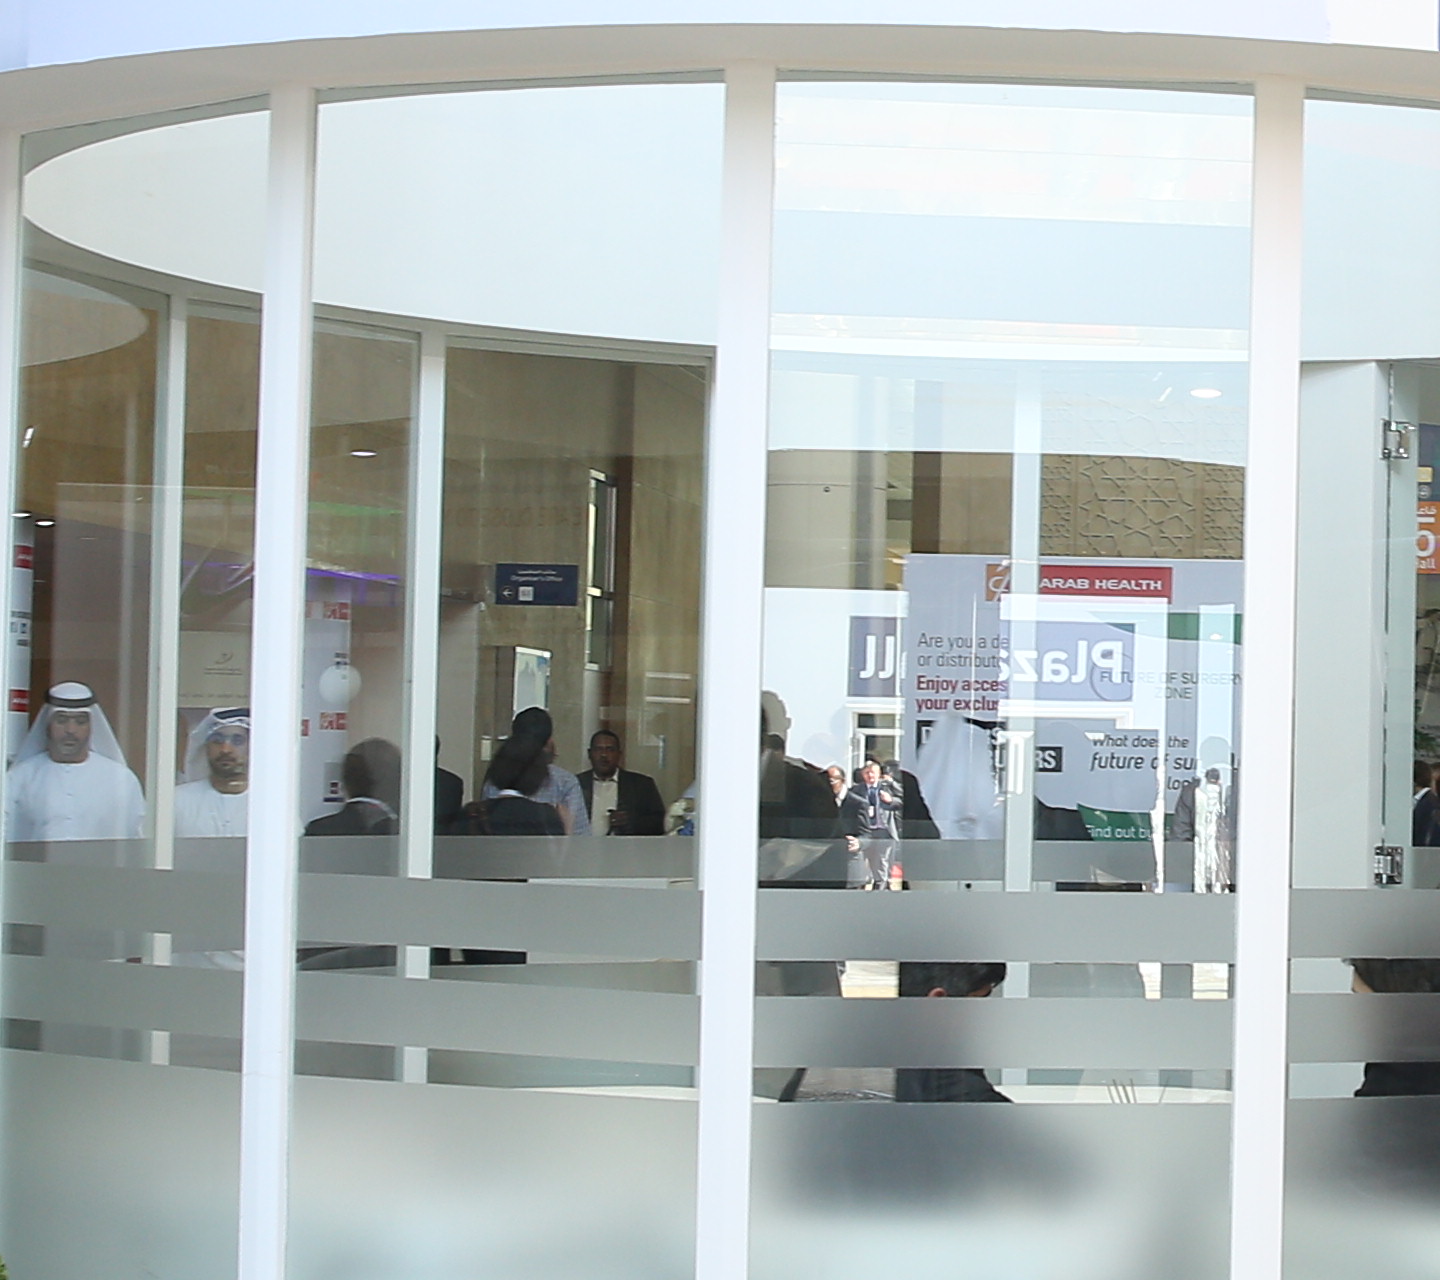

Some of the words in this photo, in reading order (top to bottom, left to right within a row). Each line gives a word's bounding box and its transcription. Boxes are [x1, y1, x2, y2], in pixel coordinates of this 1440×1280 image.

[1039, 578, 1088, 590] ARAB
[1094, 578, 1162, 591] HEALTH
[918, 633, 945, 648] Are
[947, 636, 973, 652] you
[976, 637, 987, 649] a
[917, 655, 934, 667] or
[917, 675, 957, 694] Enjoy
[1159, 672, 1177, 684] OF
[1154, 687, 1192, 700] ZONE
[916, 697, 950, 712] your
[1091, 734, 1128, 747] What
[1167, 736, 1188, 748] the
[1091, 753, 1143, 771] future
[1115, 826, 1135, 838] out
